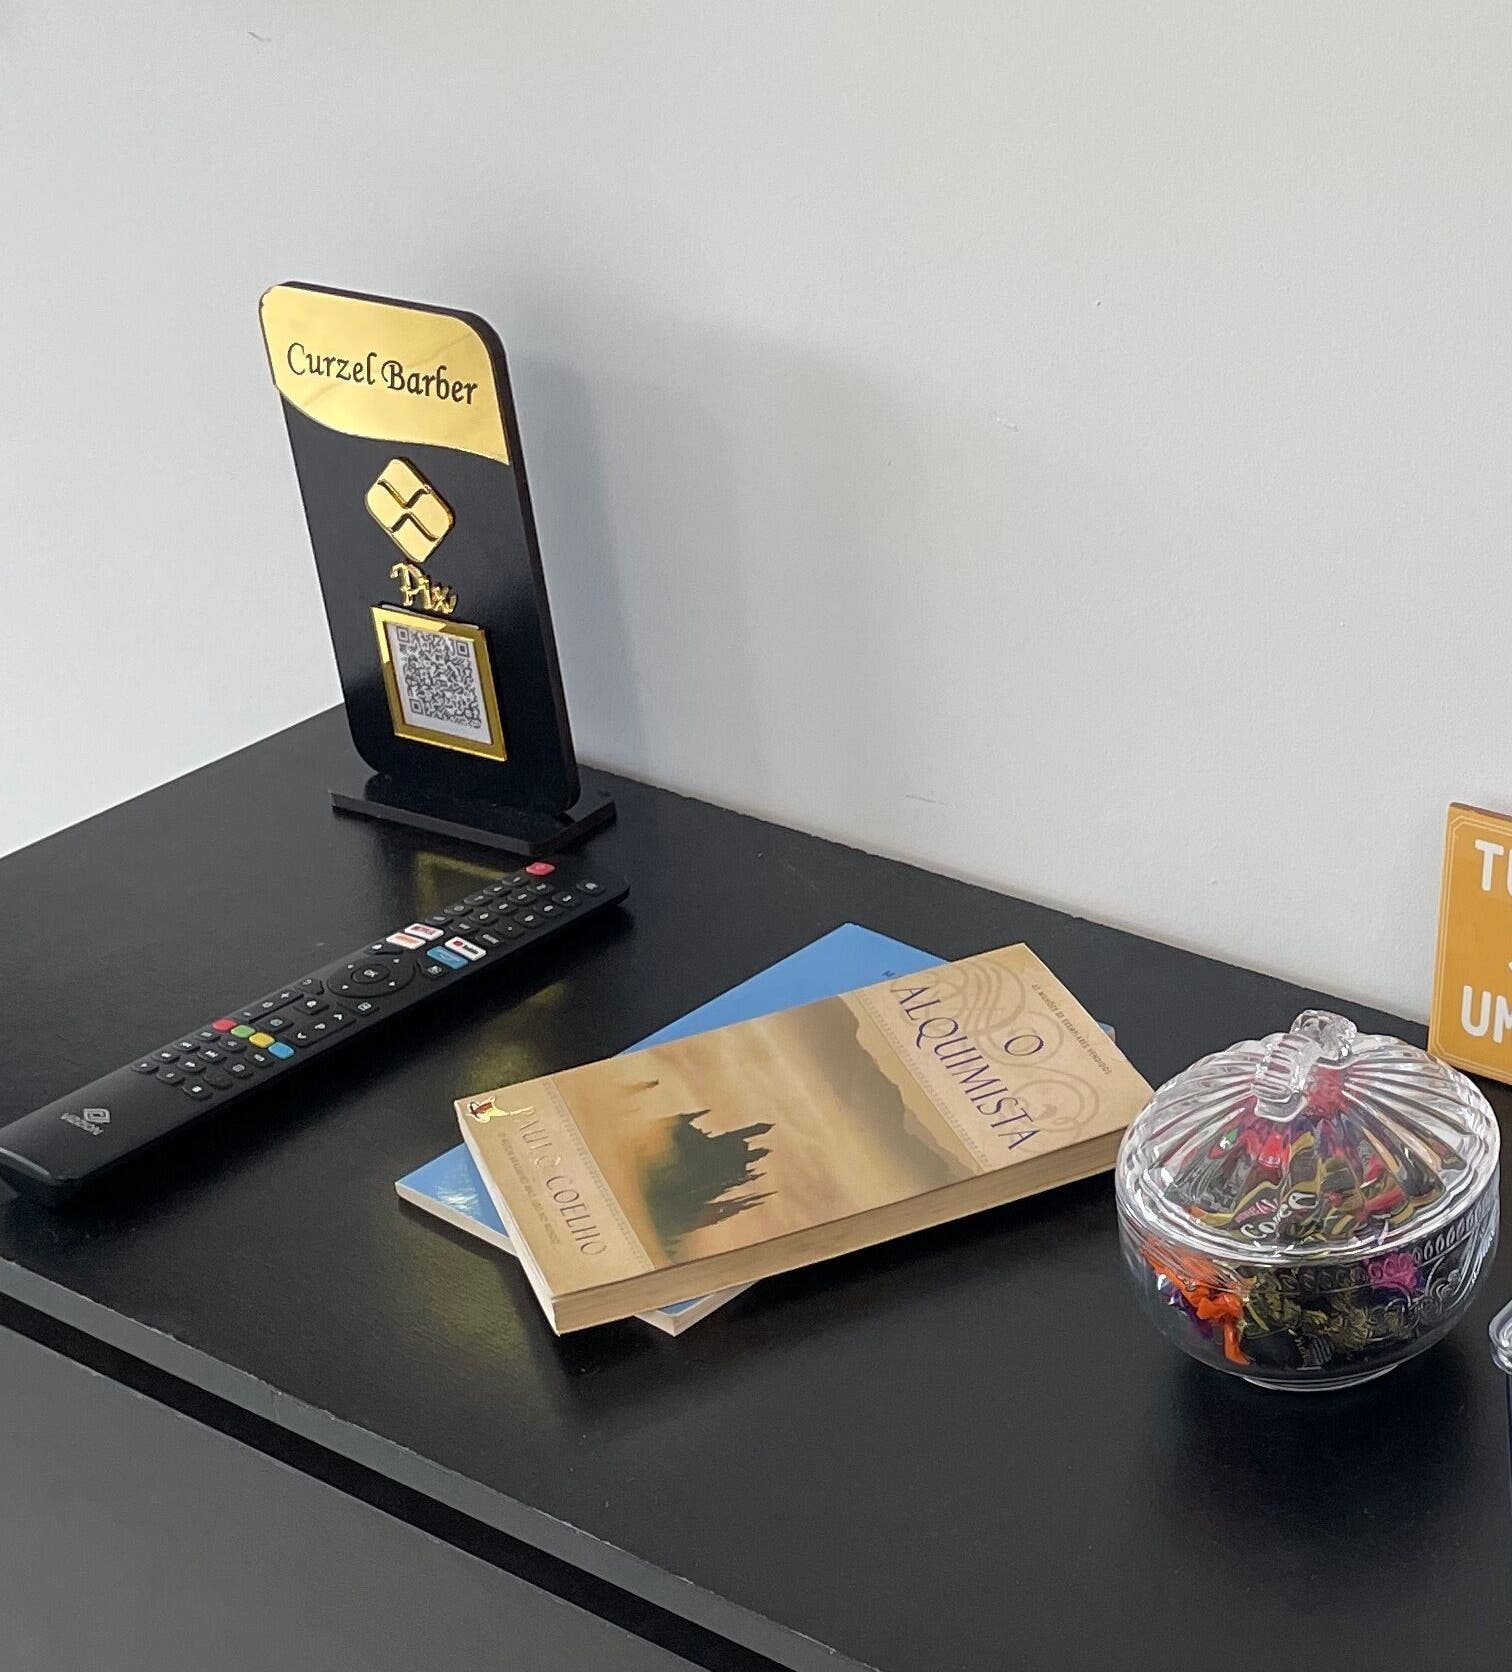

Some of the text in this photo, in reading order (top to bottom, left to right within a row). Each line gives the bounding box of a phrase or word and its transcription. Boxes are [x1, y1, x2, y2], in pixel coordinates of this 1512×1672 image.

[287, 342, 478, 405] Curzel Barber
[390, 562, 458, 615] Pix
[890, 985, 1041, 1151] ALQUIMISTA
[1004, 1034, 1044, 1057] O
